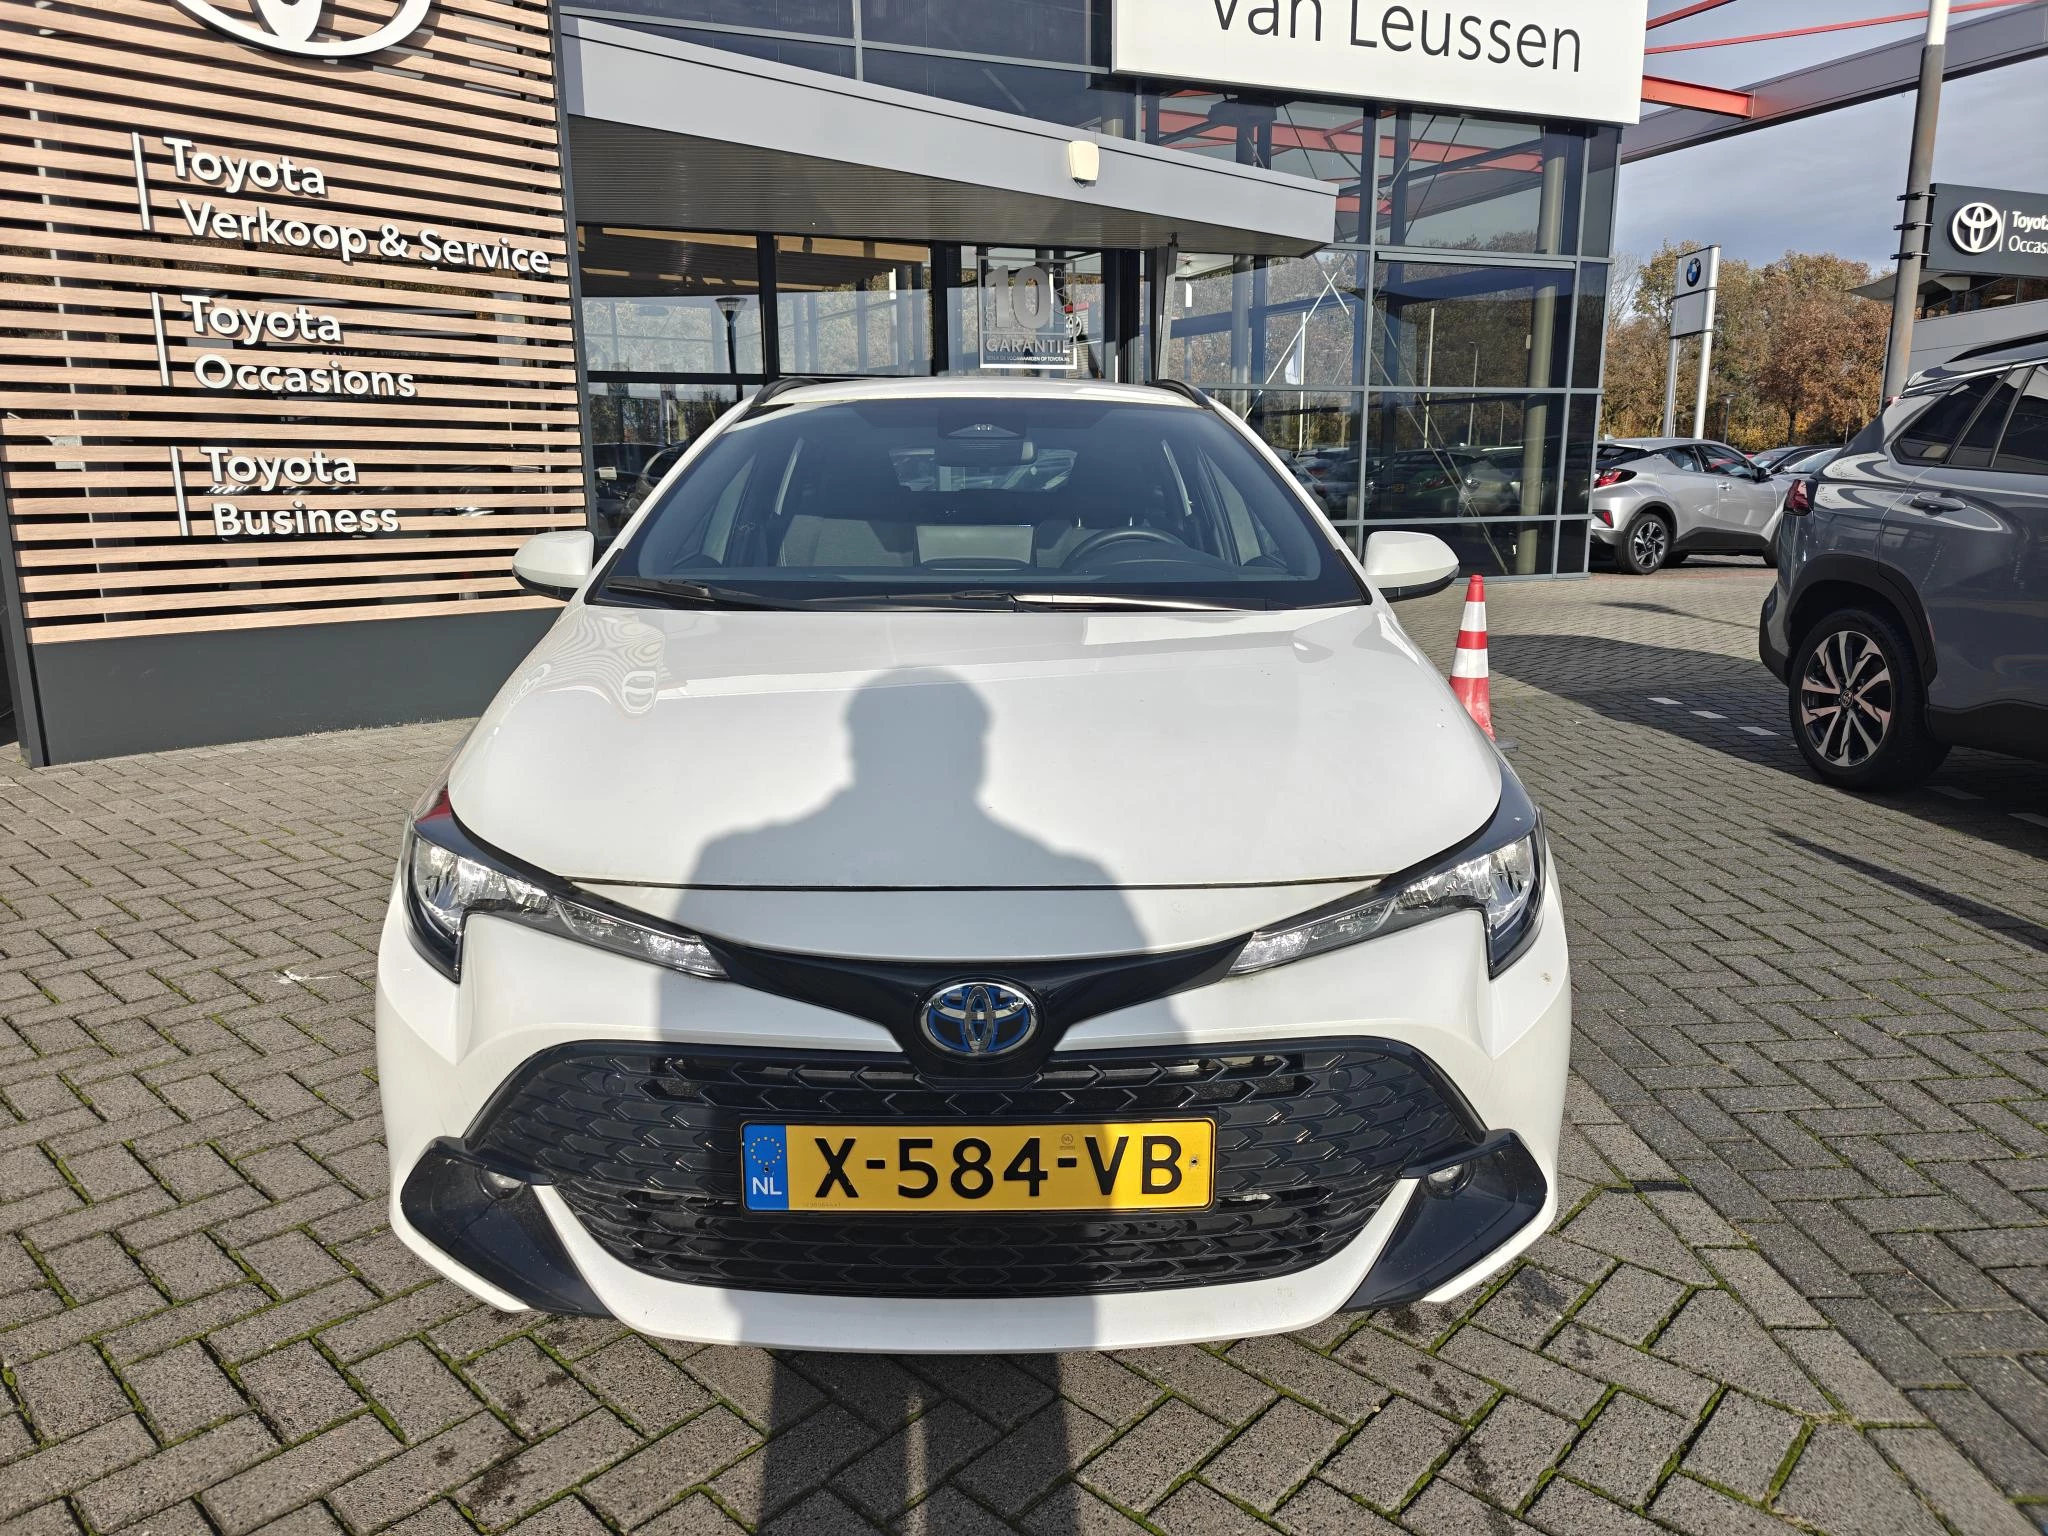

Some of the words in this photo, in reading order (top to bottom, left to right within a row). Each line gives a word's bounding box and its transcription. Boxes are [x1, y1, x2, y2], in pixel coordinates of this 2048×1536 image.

[1350, 0, 1580, 72] Leussen
[162, 136, 325, 195] Toyota
[176, 197, 368, 262] Verkoop
[378, 223, 409, 258] &
[419, 228, 550, 274] Service
[181, 294, 342, 345] Toyota
[985, 265, 1050, 329] 10
[986, 339, 1071, 354] GARANTIE
[194, 354, 417, 398] Occasions
[200, 446, 357, 492] Toyota
[212, 501, 400, 536] Business
[752, 1176, 783, 1196] NL
[814, 1135, 1183, 1198] X-584-VB
